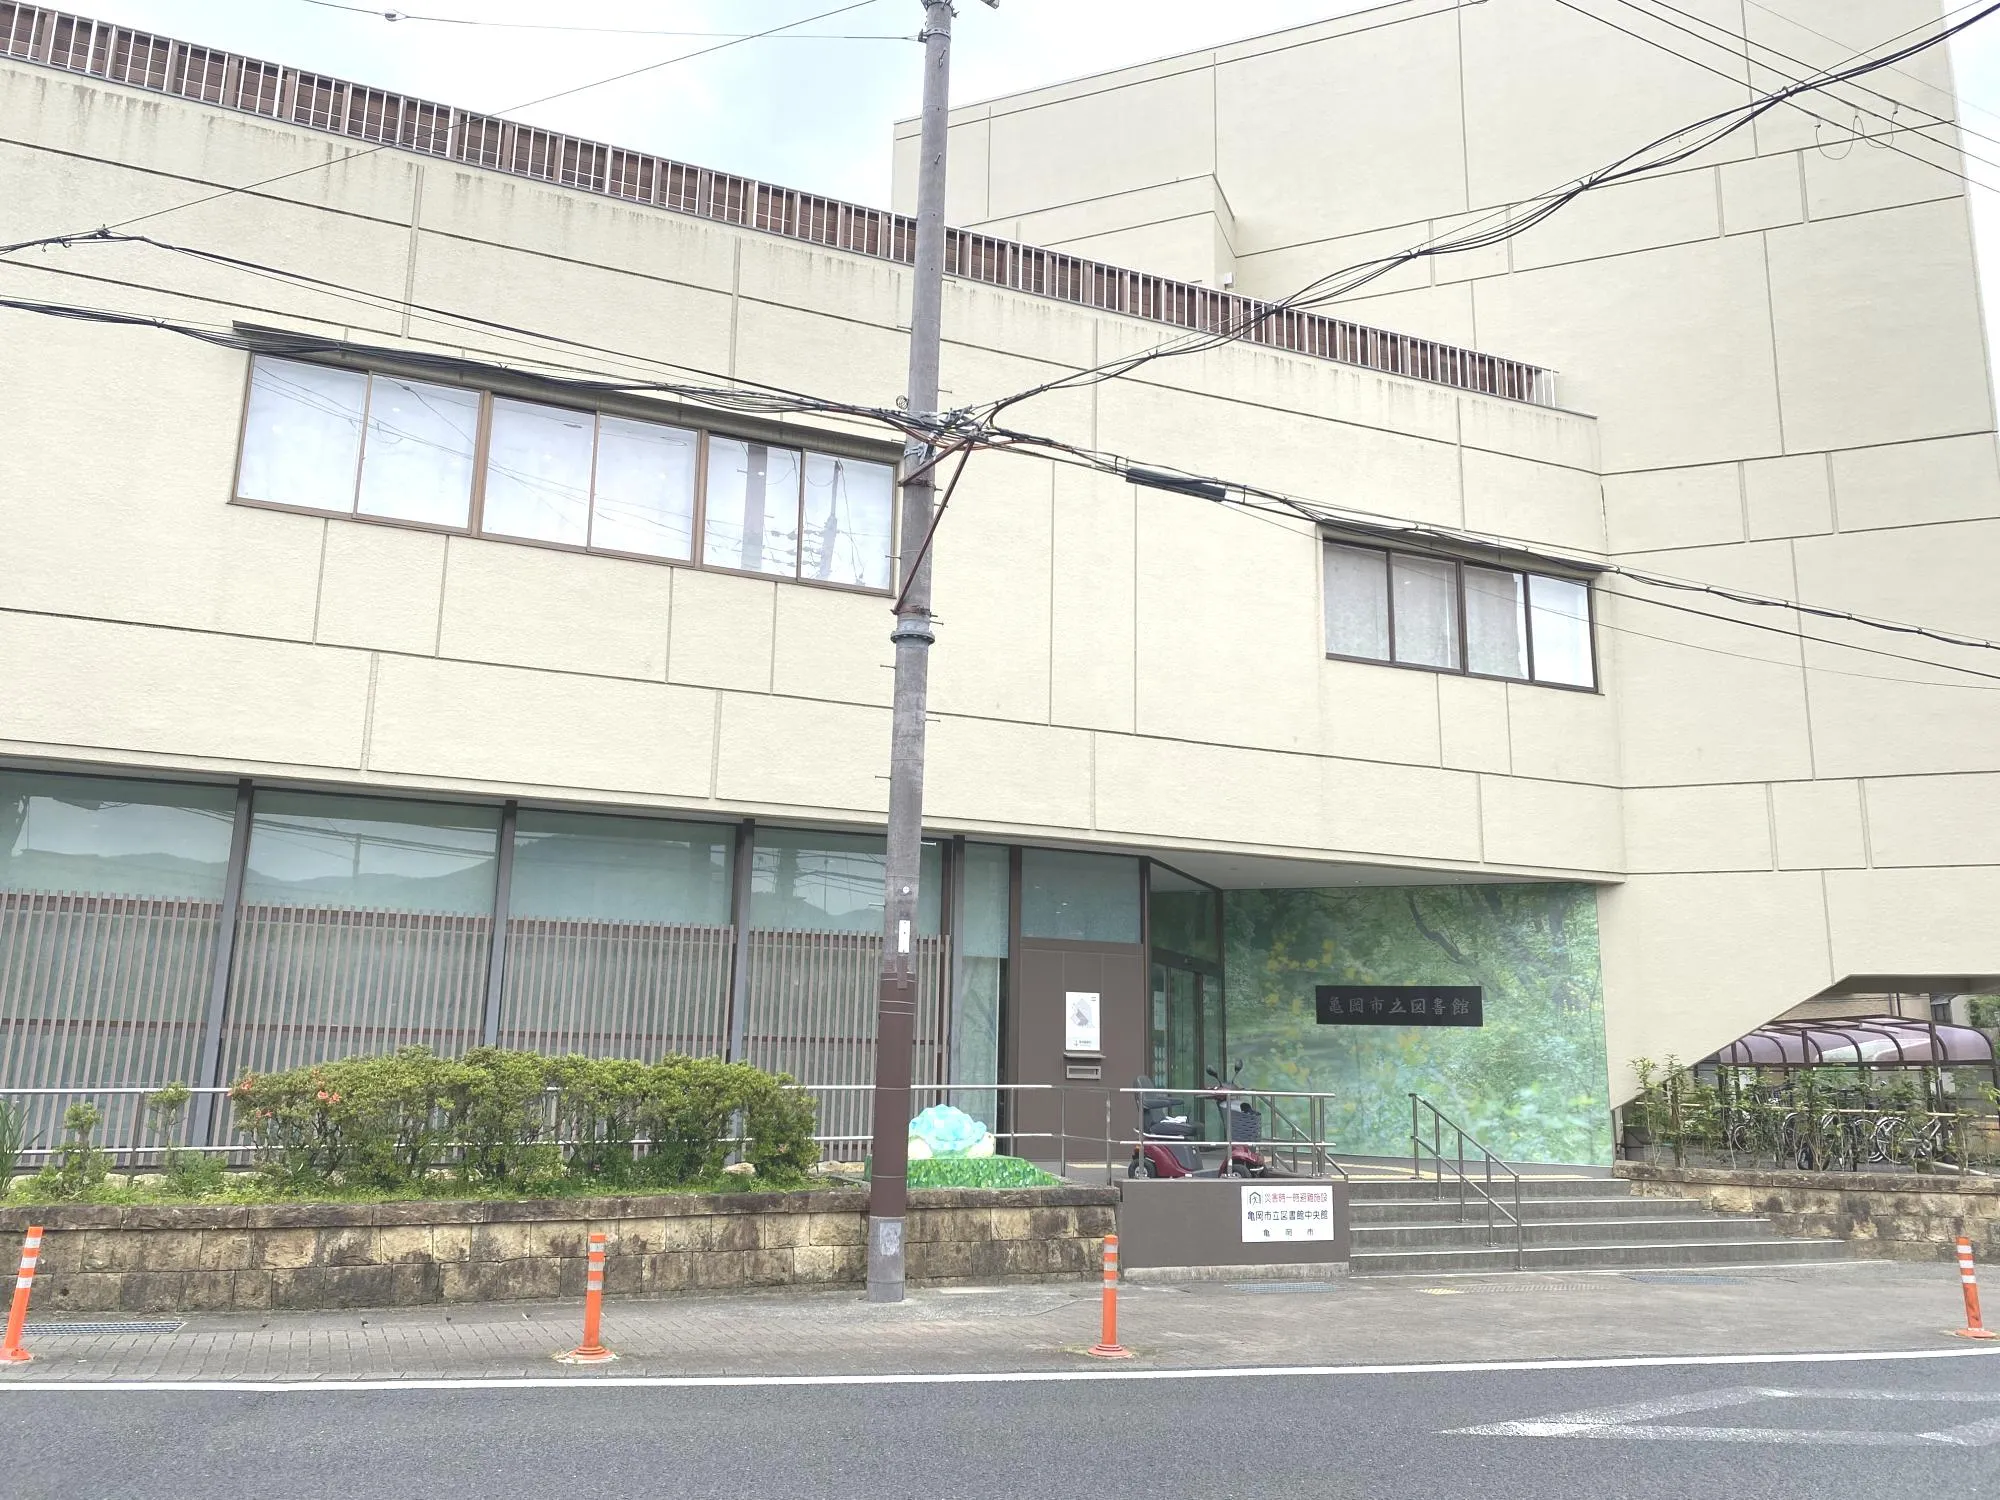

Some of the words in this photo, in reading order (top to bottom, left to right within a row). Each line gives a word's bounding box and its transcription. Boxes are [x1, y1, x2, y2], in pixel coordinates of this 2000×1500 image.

[1247, 1210, 1329, 1221] 亀岡市立図書館中央館
